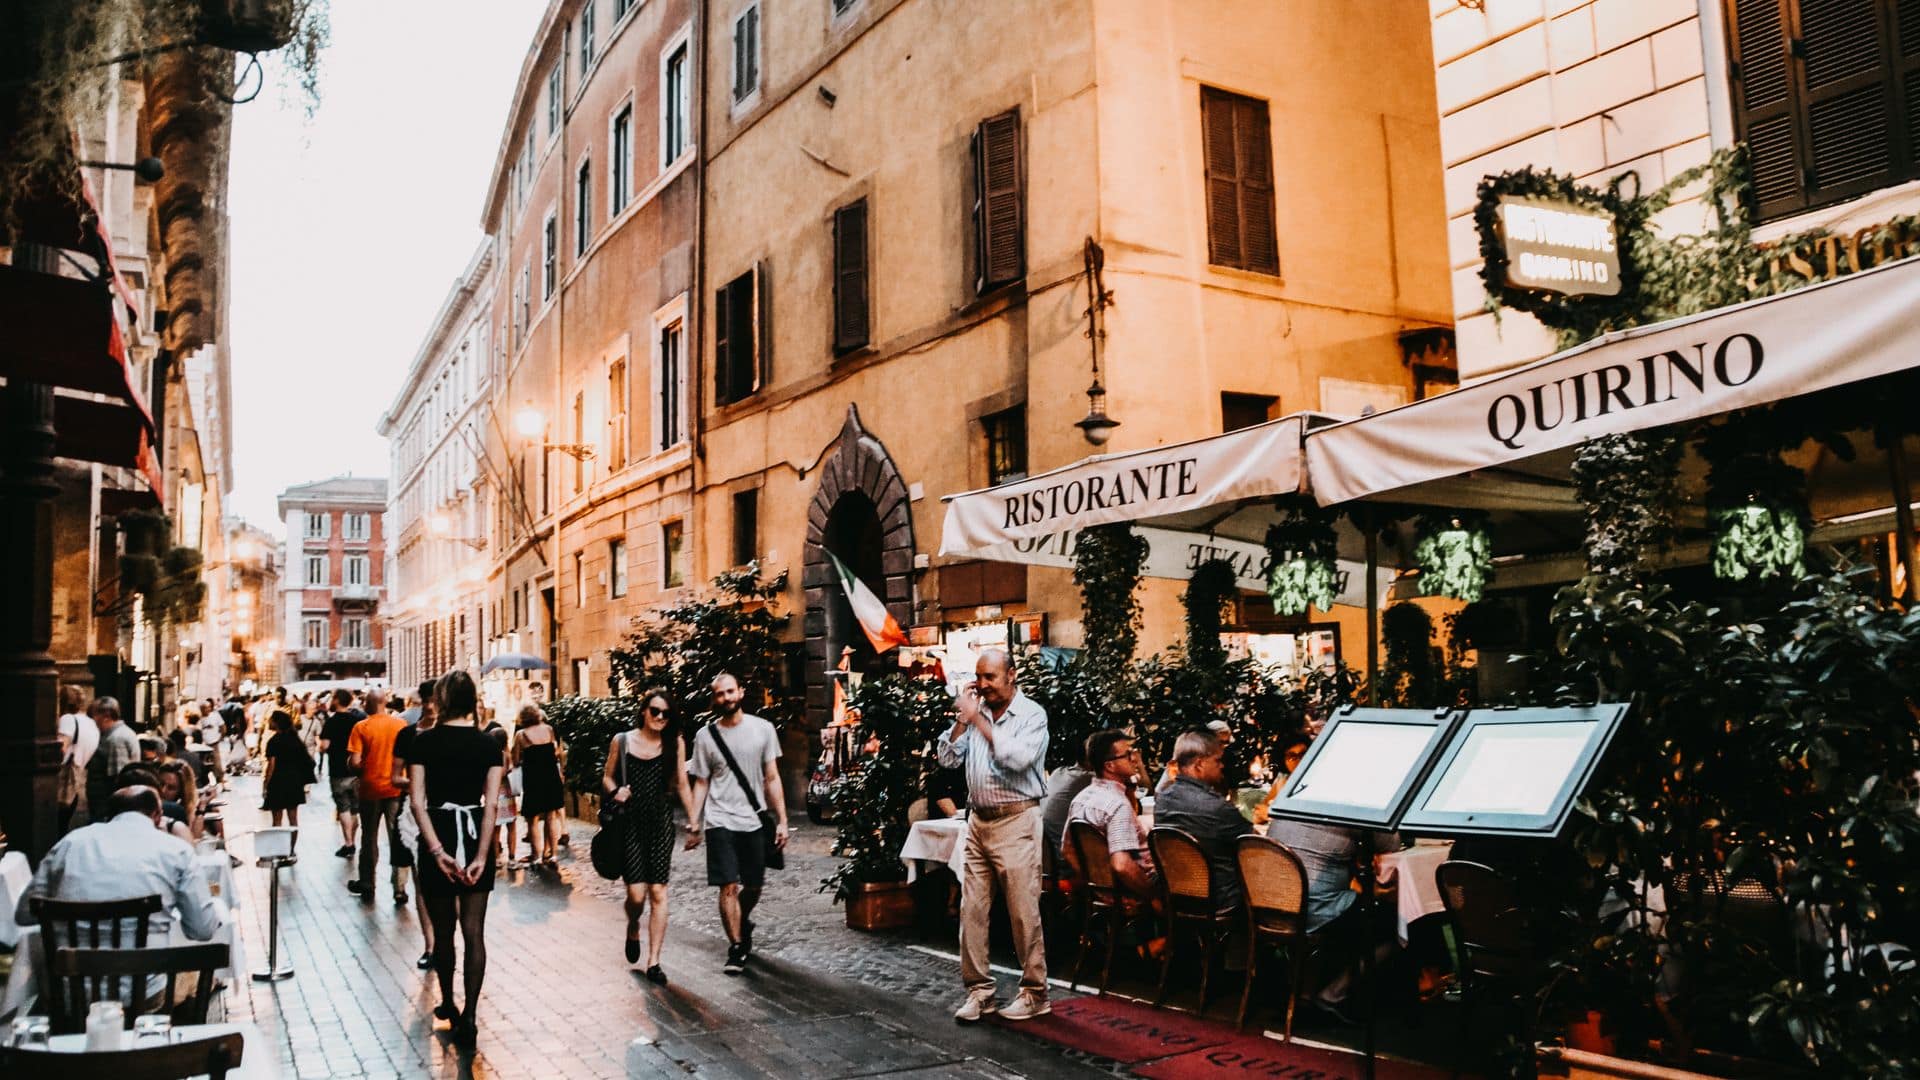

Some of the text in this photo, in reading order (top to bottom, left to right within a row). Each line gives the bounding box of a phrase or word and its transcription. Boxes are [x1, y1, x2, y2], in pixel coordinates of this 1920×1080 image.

[1487, 332, 1765, 450] QUIRINO
[1003, 458, 1198, 529] RISTORANTE
[1205, 1051, 1347, 1080] QUIR
